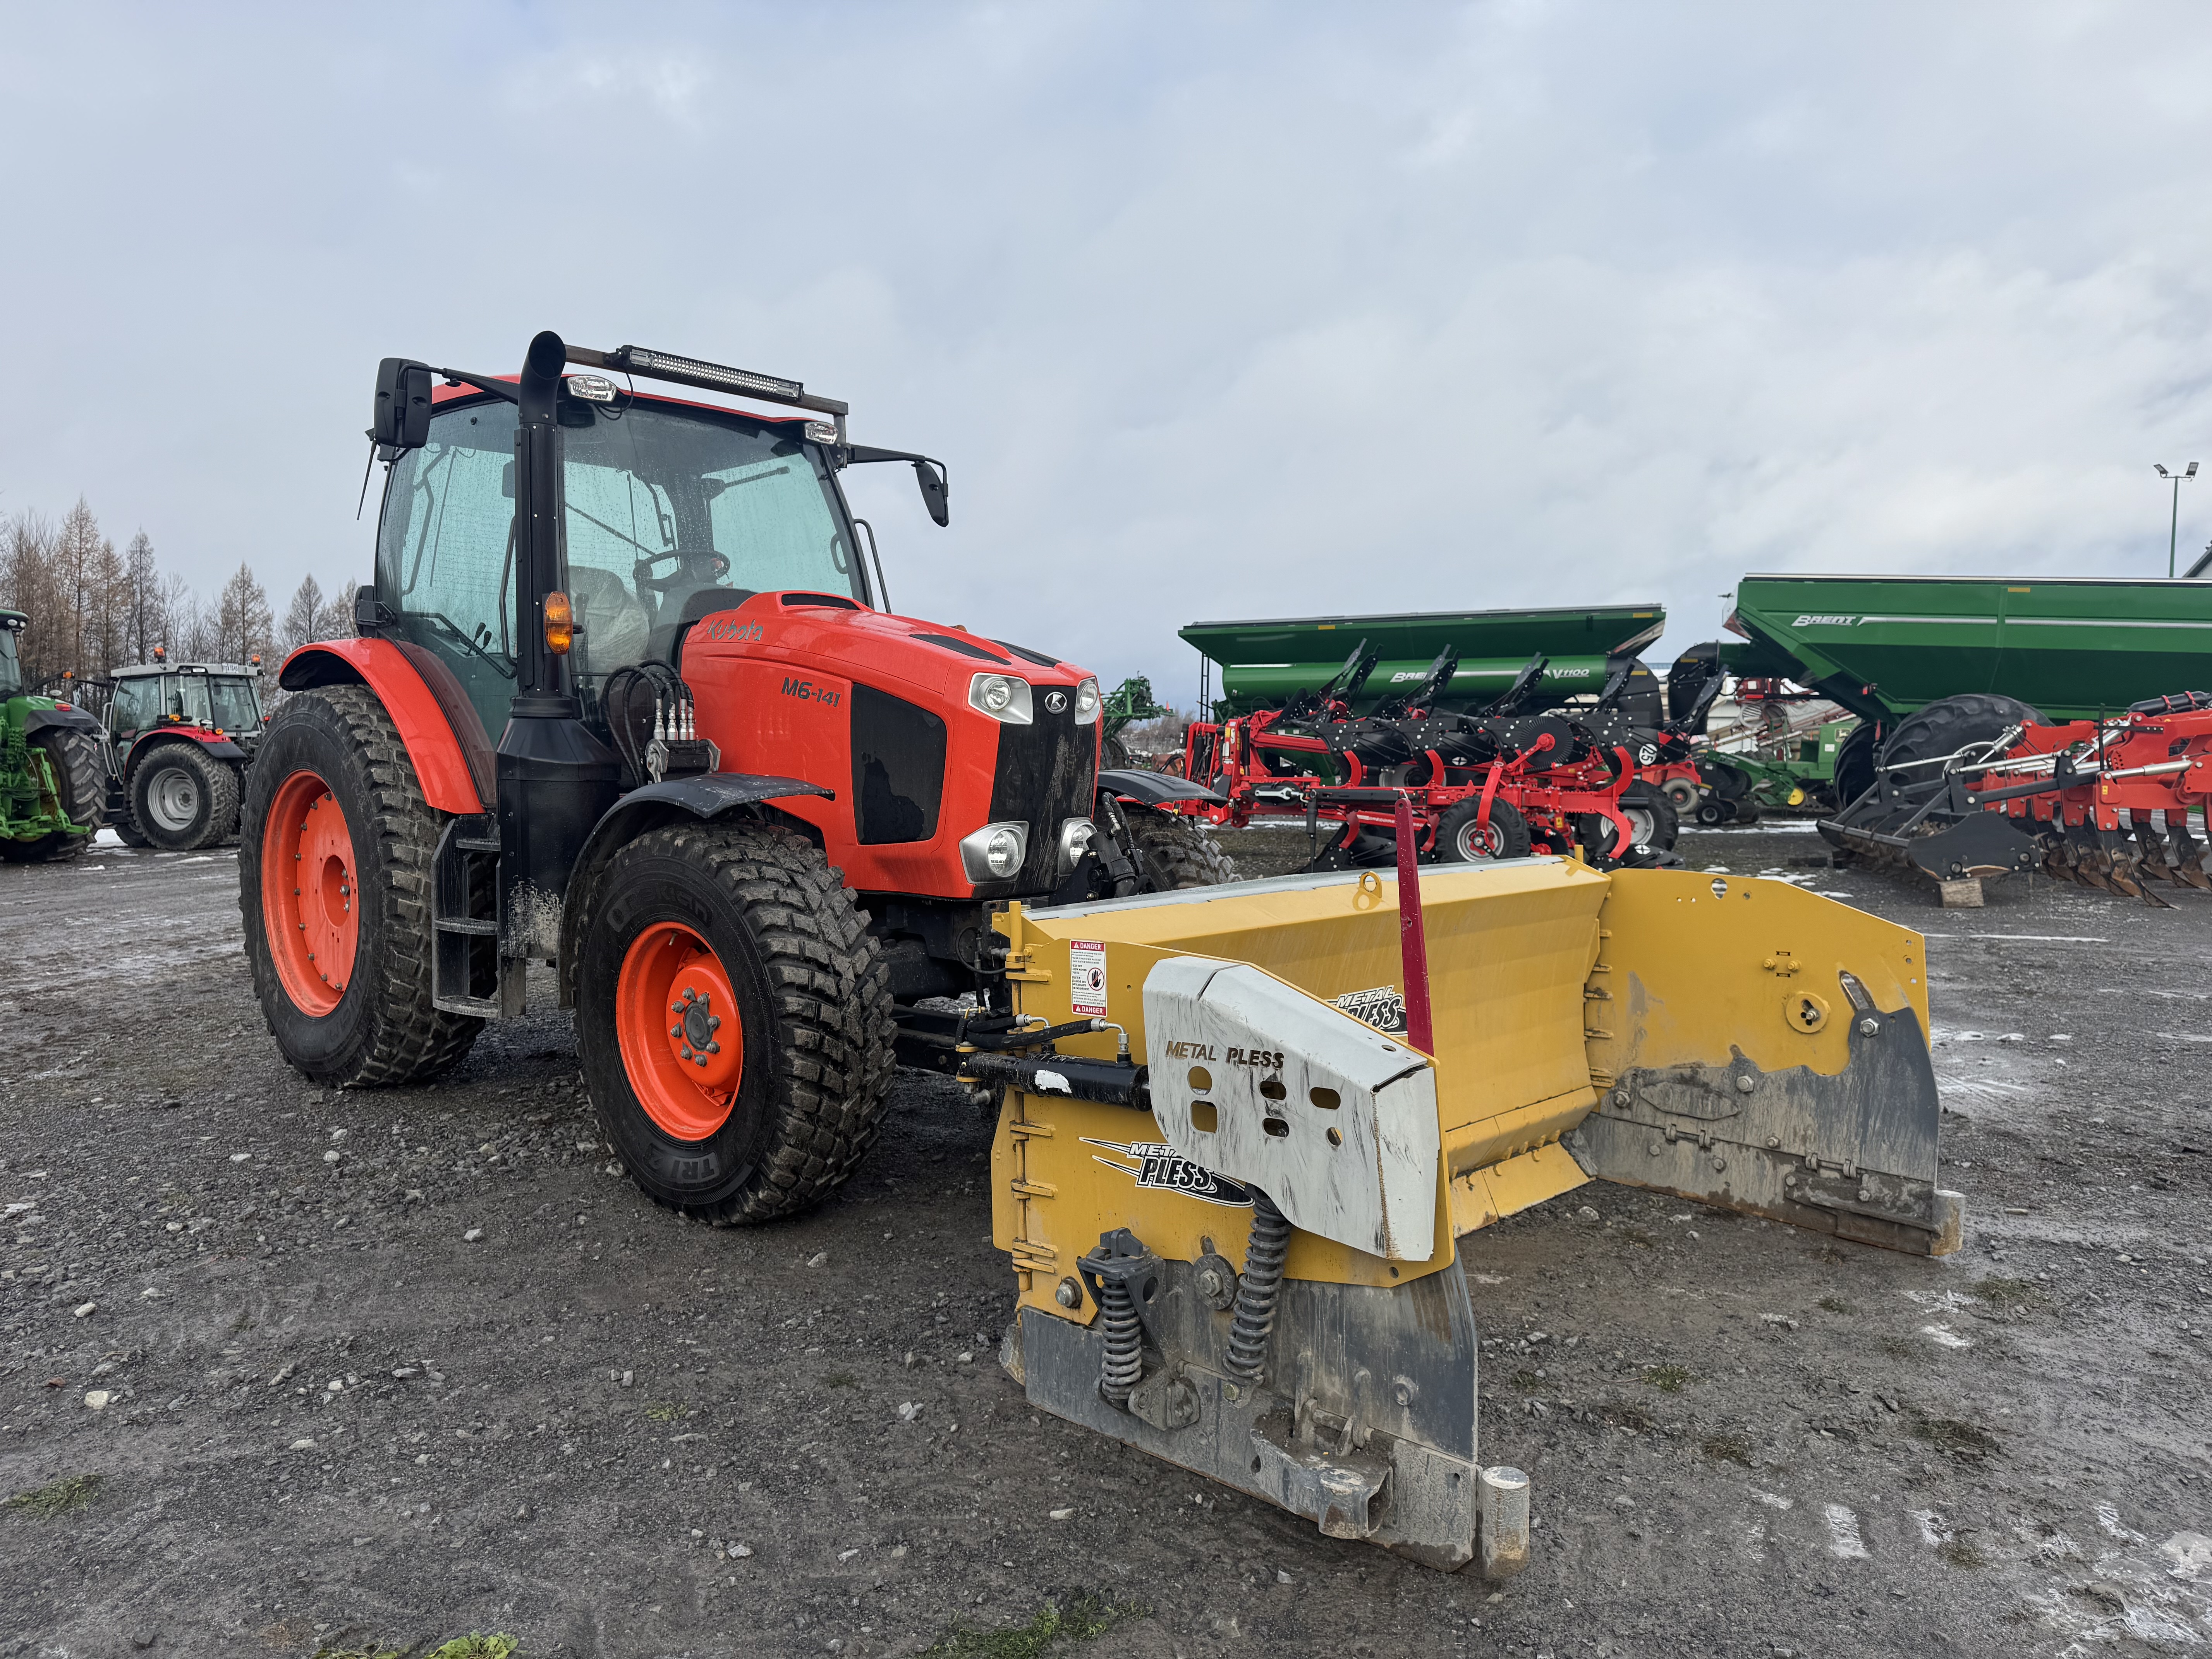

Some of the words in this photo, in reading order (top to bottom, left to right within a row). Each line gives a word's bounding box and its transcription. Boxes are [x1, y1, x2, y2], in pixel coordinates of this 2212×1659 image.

[707, 619, 763, 641] Kubota
[1791, 615, 1856, 626] BRENT
[1389, 672, 1438, 682] BRE
[1553, 669, 1589, 679] V1100
[781, 677, 841, 707] M6-141
[1337, 986, 1395, 1008] METAL
[1166, 1041, 1217, 1061] METAL
[1226, 1047, 1284, 1069] PLESS
[1129, 1143, 1182, 1157] MET
[670, 1158, 714, 1179] TRI
[1139, 1157, 1211, 1190] PLESS
